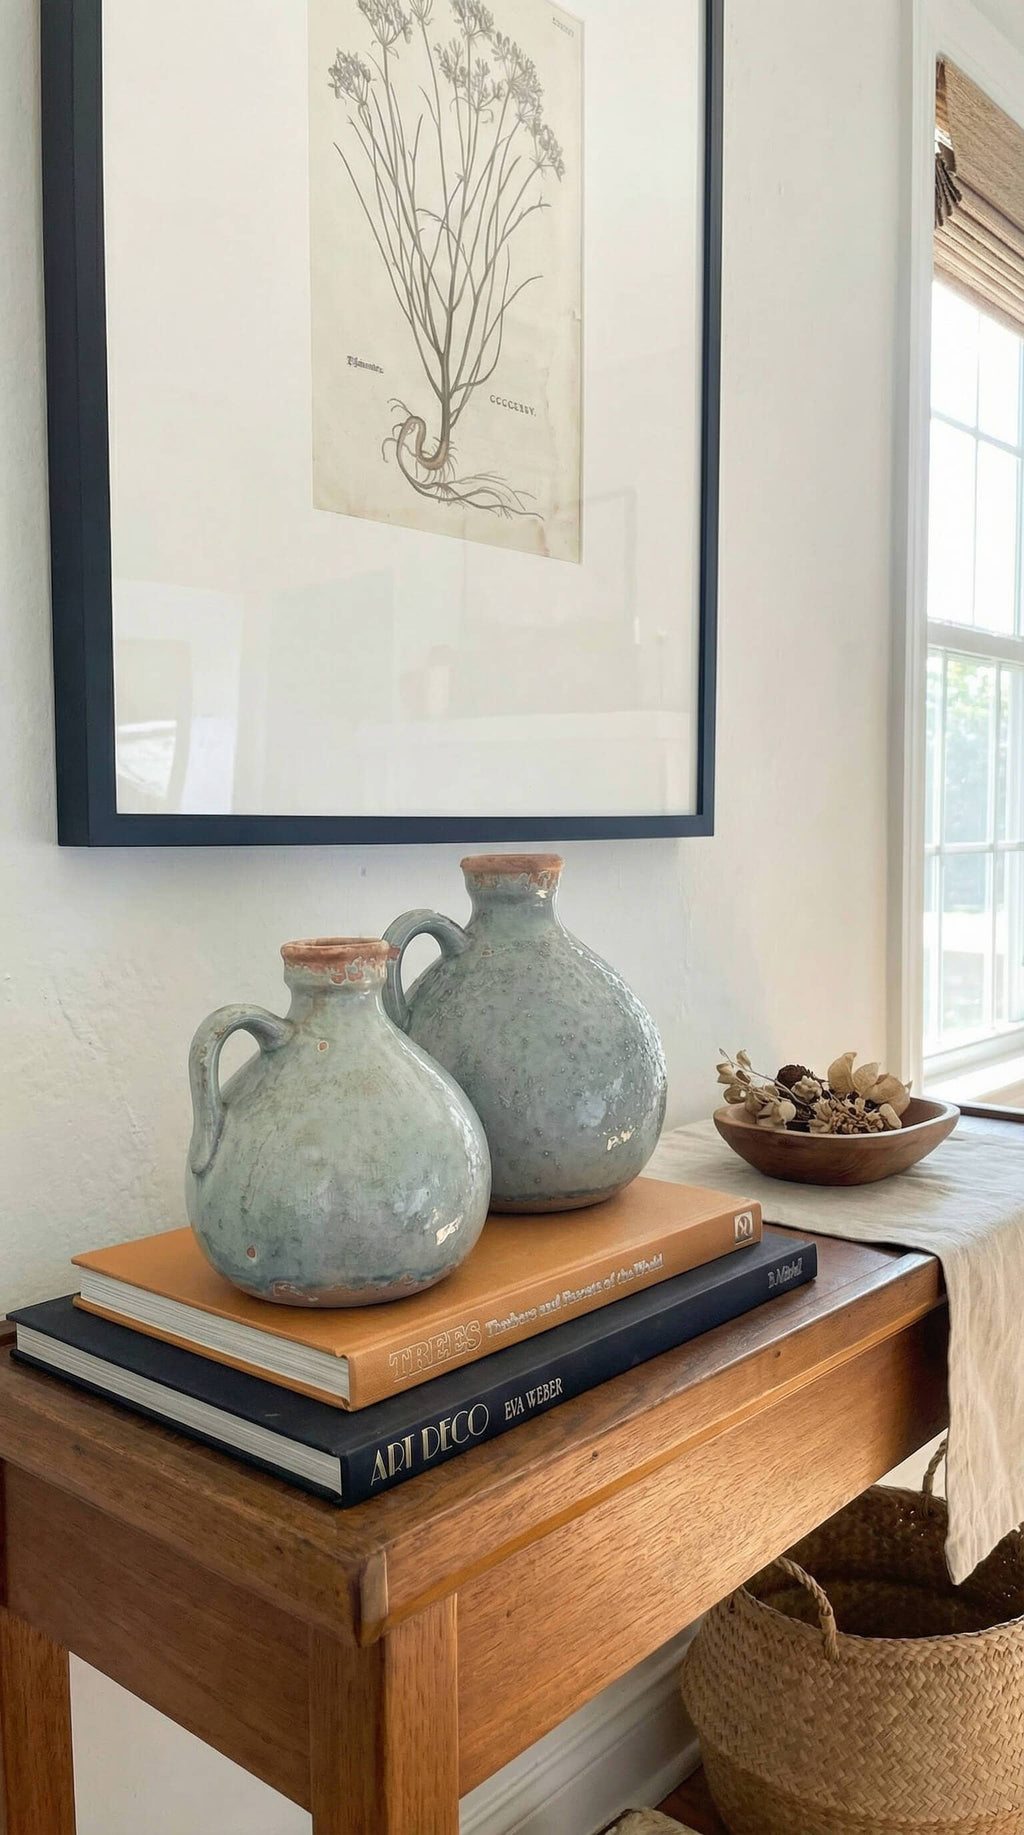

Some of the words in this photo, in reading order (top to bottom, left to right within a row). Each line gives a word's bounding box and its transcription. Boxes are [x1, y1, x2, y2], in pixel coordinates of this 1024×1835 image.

[389, 1320, 482, 1383] TREES
[370, 1433, 415, 1486] ART
[421, 1403, 490, 1461] DECO
[504, 1396, 525, 1421] EVA
[525, 1377, 563, 1409] WEBER
